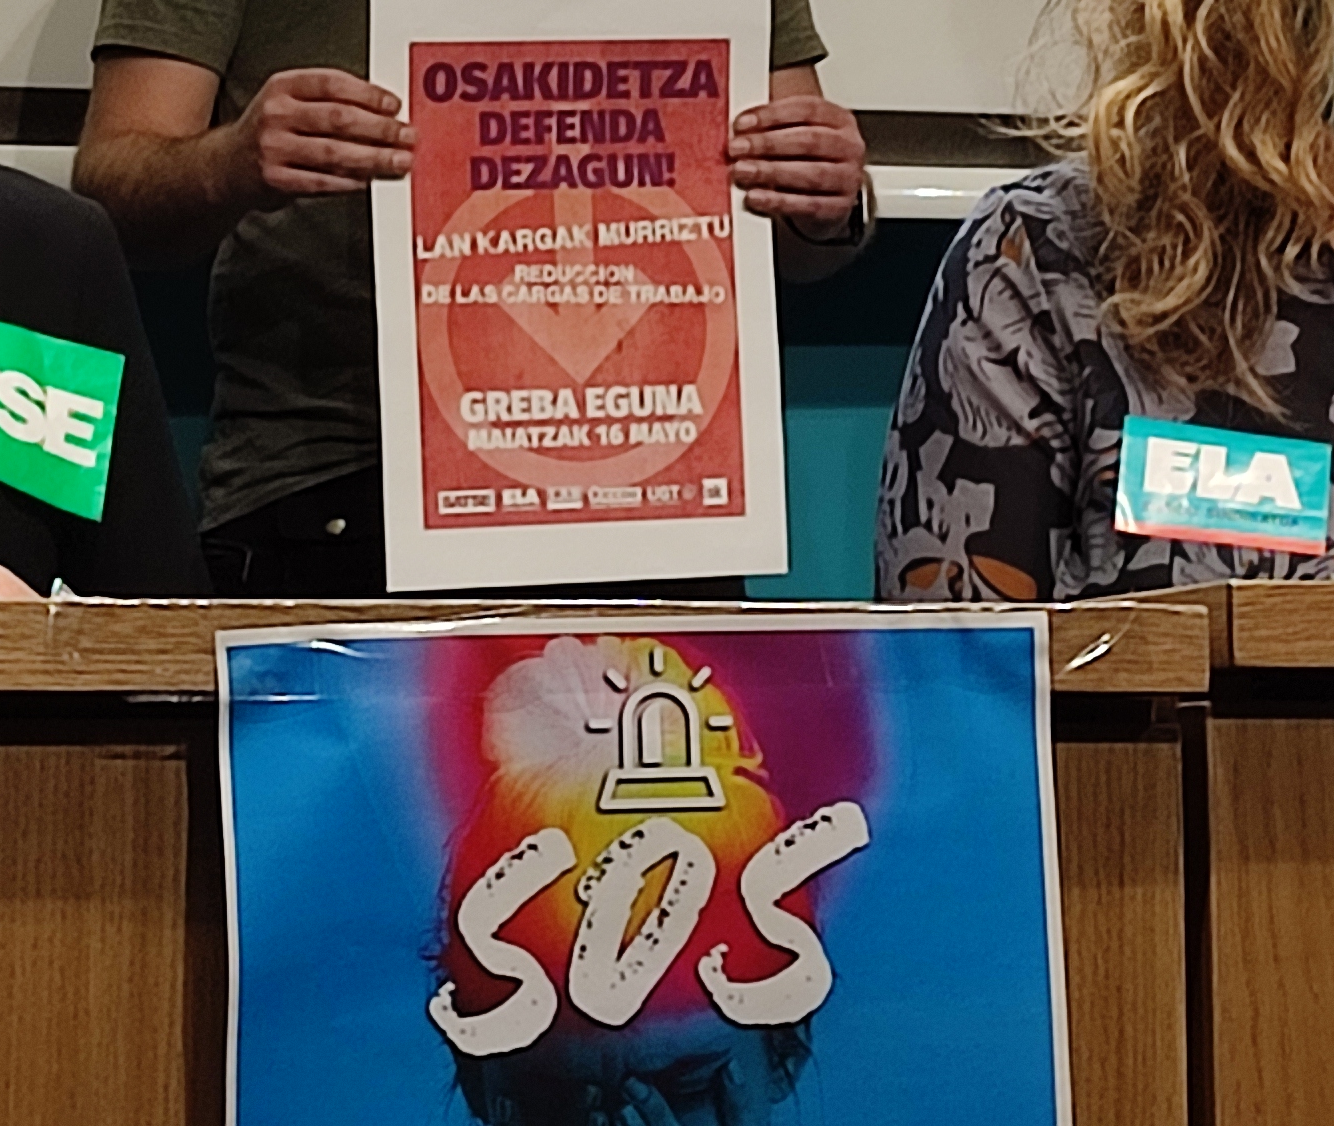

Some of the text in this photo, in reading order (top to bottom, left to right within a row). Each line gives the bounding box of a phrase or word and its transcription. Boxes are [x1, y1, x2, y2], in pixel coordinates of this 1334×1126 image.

[423, 59, 719, 103] OSAKIDETZA
[479, 108, 666, 146] DEFENDA
[470, 151, 676, 191] DEZAGUN!
[417, 213, 731, 259] LAN KARGAK MURRIZTU
[422, 283, 726, 304] DE LAS CARGAS DE TRABAJO
[459, 384, 703, 423] GREBA EGUNA
[467, 420, 698, 451] MAIATZAK 16 MAYO
[1143, 436, 1303, 510] ELA
[428, 800, 870, 1057] SOS
